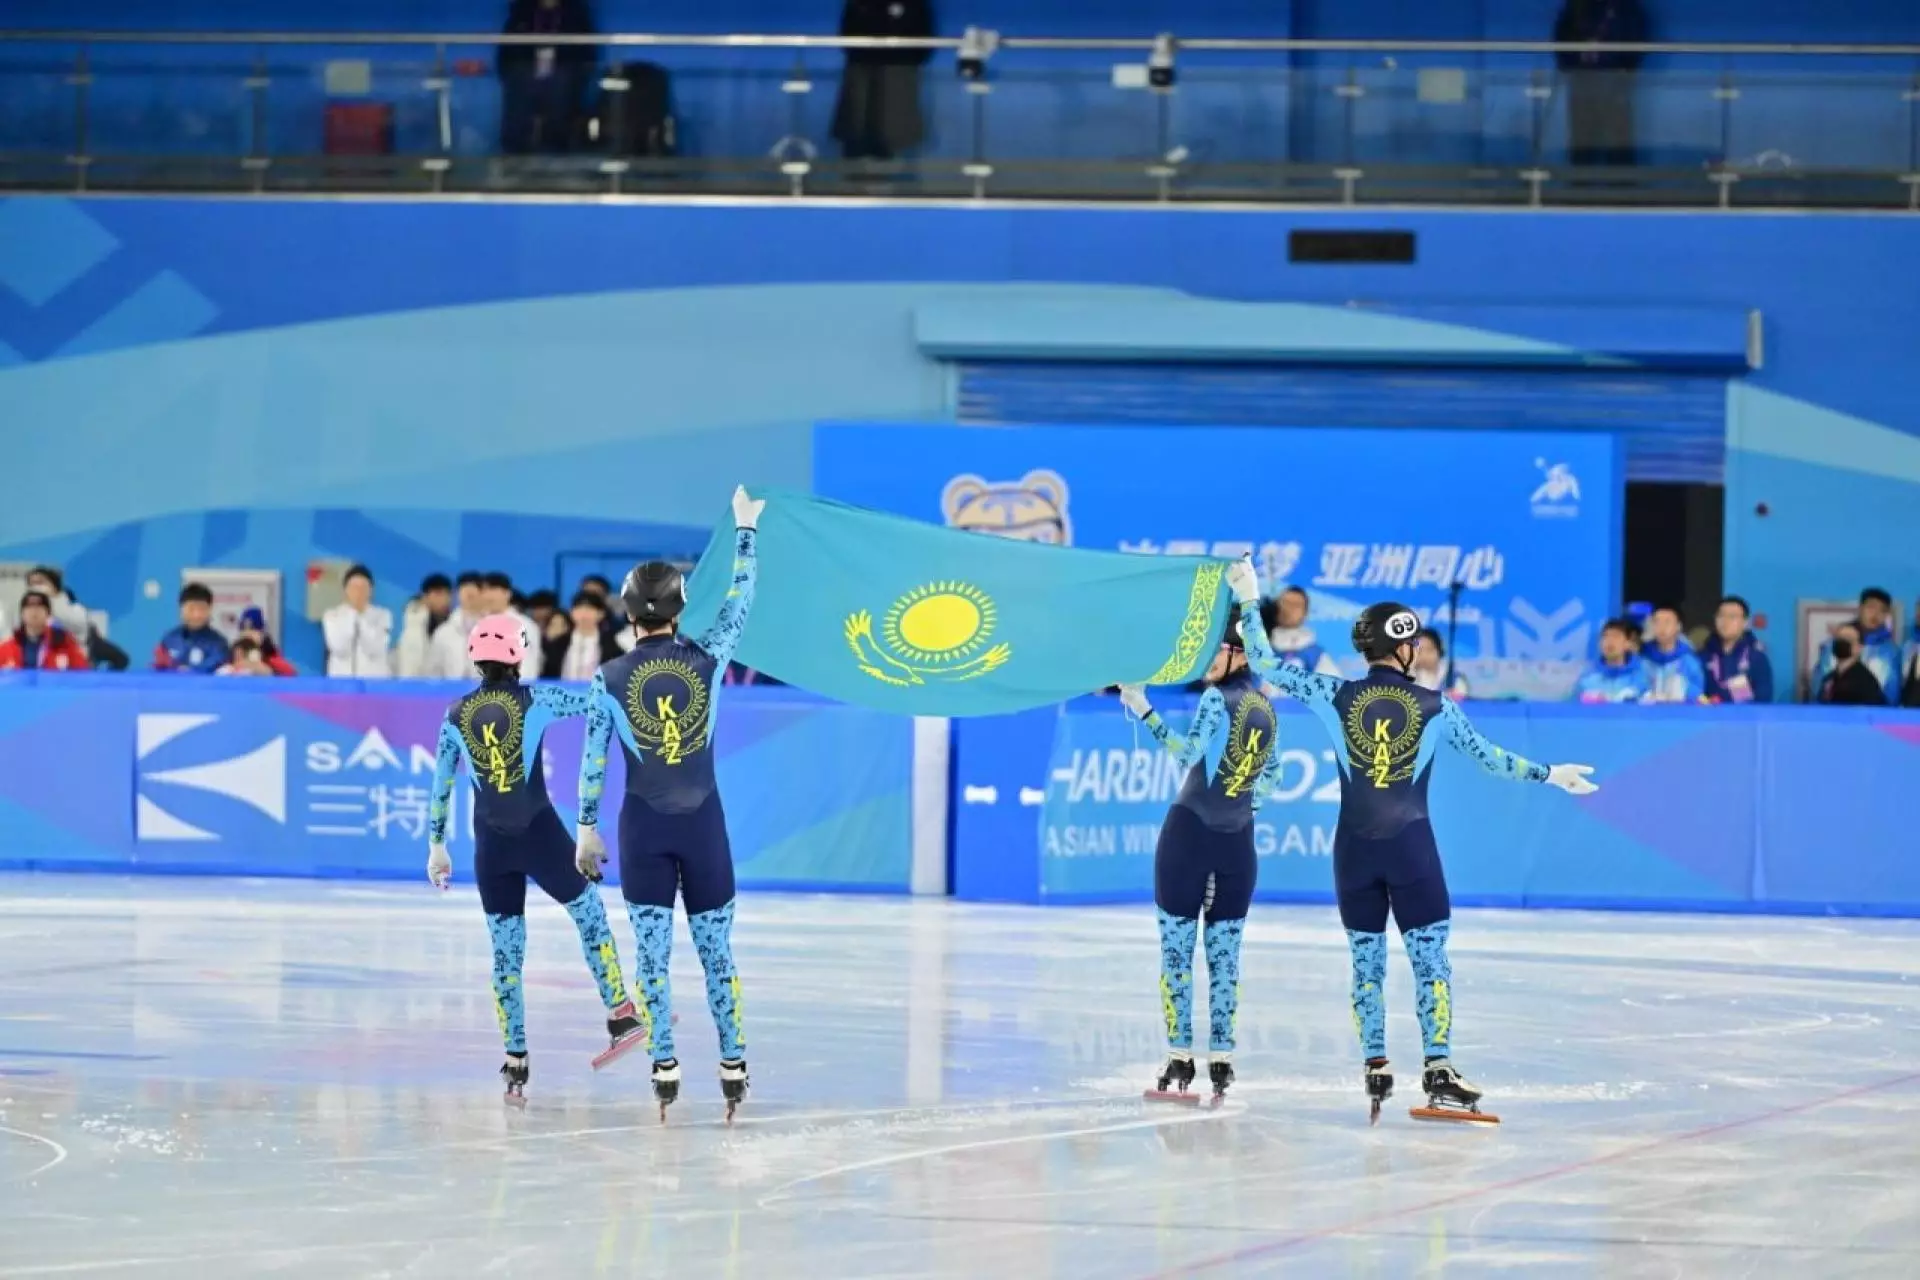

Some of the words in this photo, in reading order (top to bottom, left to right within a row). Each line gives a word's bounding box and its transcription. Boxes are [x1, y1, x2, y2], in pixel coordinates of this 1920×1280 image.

[1312, 543, 1504, 590] 亚洲同心
[1392, 615, 1414, 635] 69
[483, 722, 512, 792] KAZ
[656, 695, 681, 765] KAZ
[1225, 728, 1263, 798] KAZ
[1373, 719, 1392, 788] KAZ
[1046, 824, 1117, 859] ASIAN
[1254, 822, 1336, 857] GAM
[1433, 980, 1450, 1043] KAZ
